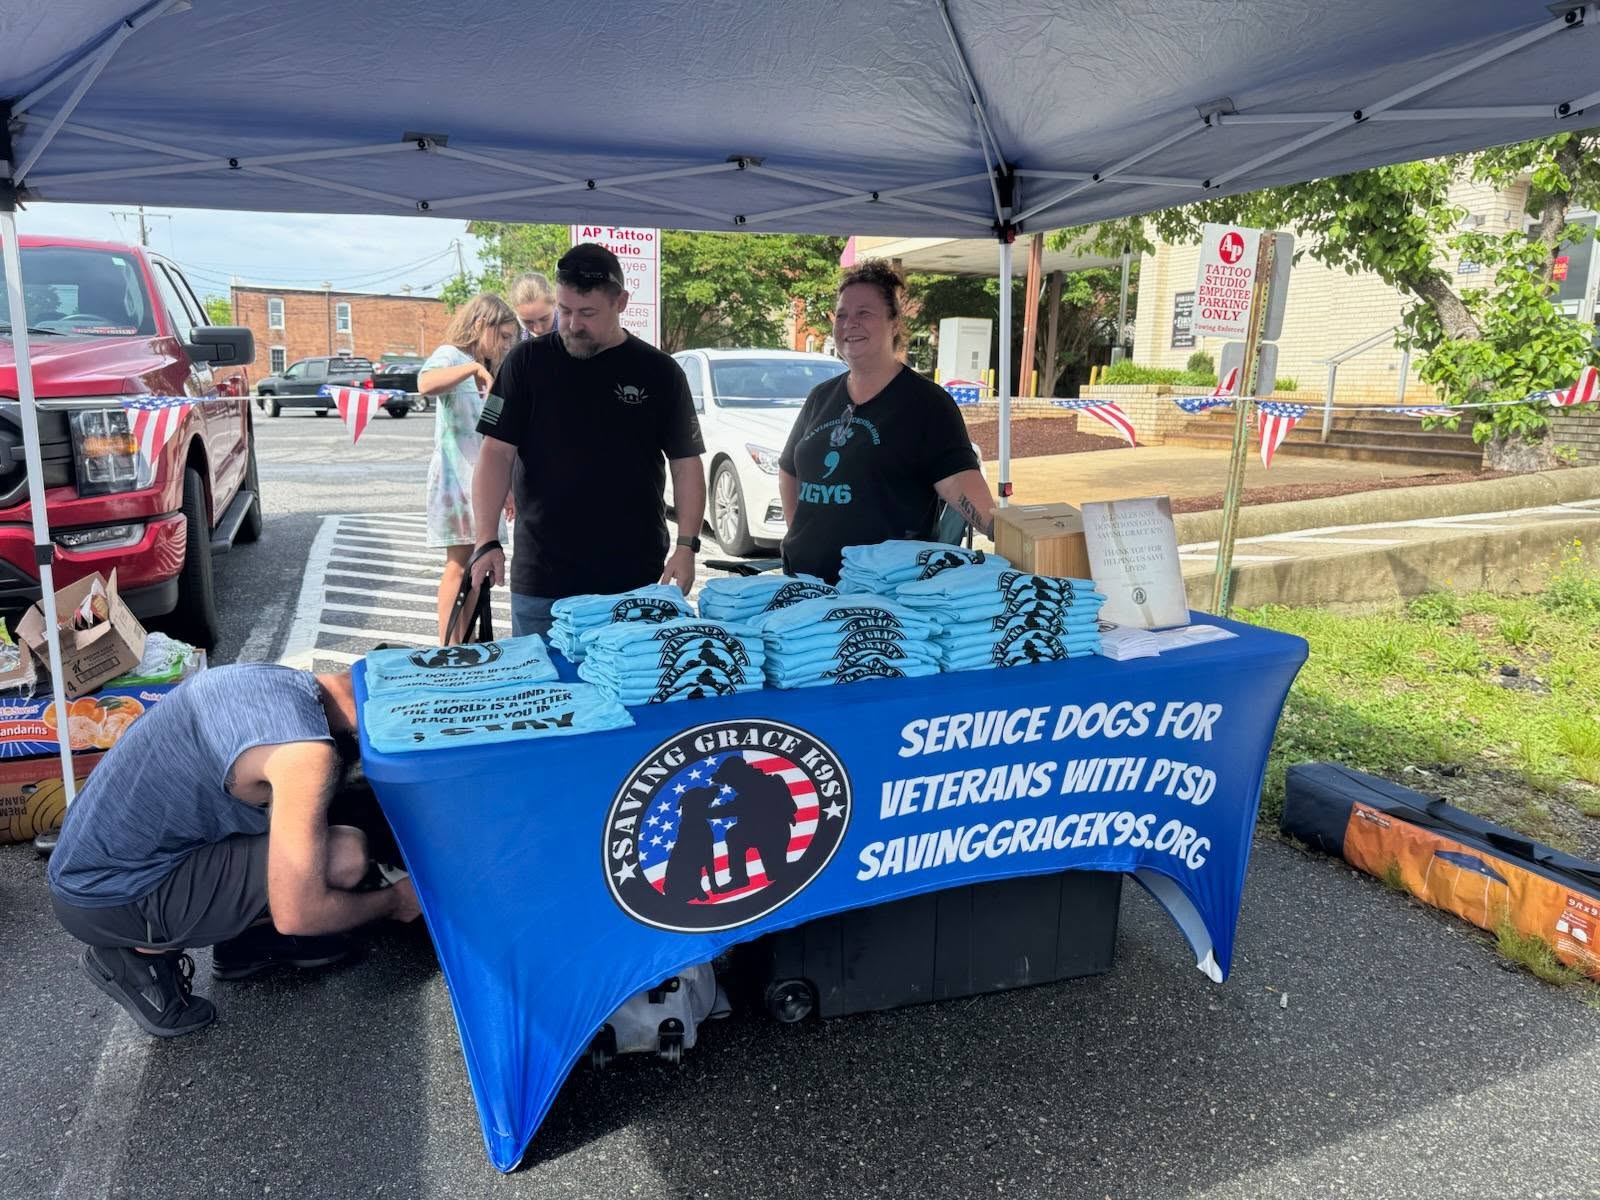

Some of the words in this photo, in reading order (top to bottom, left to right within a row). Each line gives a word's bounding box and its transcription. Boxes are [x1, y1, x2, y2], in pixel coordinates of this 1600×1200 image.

[582, 227, 602, 238] AP
[607, 228, 654, 242] Tattoo
[1221, 234, 1243, 262] AP
[1205, 264, 1251, 278] TATTOO
[1205, 276, 1247, 288] STUDIO
[1199, 286, 1251, 300] EMPLOYEE
[1198, 297, 1249, 310] PARKING
[1202, 308, 1242, 321] ONLY
[1194, 323, 1217, 333] Towing
[1217, 324, 1245, 333] Enforced
[799, 481, 852, 505] IGY6
[67, 681, 77, 692] 4
[433, 703, 487, 714] WORLD
[490, 702, 505, 710] IS
[462, 713, 499, 723] WITH
[503, 708, 533, 719] YOU
[0, 723, 48, 737] andarins
[898, 704, 1052, 758] SERVICE
[1051, 701, 1156, 742] DOGS
[1155, 701, 1223, 742] FOR
[612, 745, 687, 861] SAVING
[694, 728, 802, 754] GRACE
[800, 746, 841, 798] K9S
[879, 760, 1057, 820] VETERANS
[1060, 757, 1146, 795] WITH
[1145, 758, 1217, 806] PTSD
[856, 810, 1211, 882] SAVINGGRACEK9S.ORG
